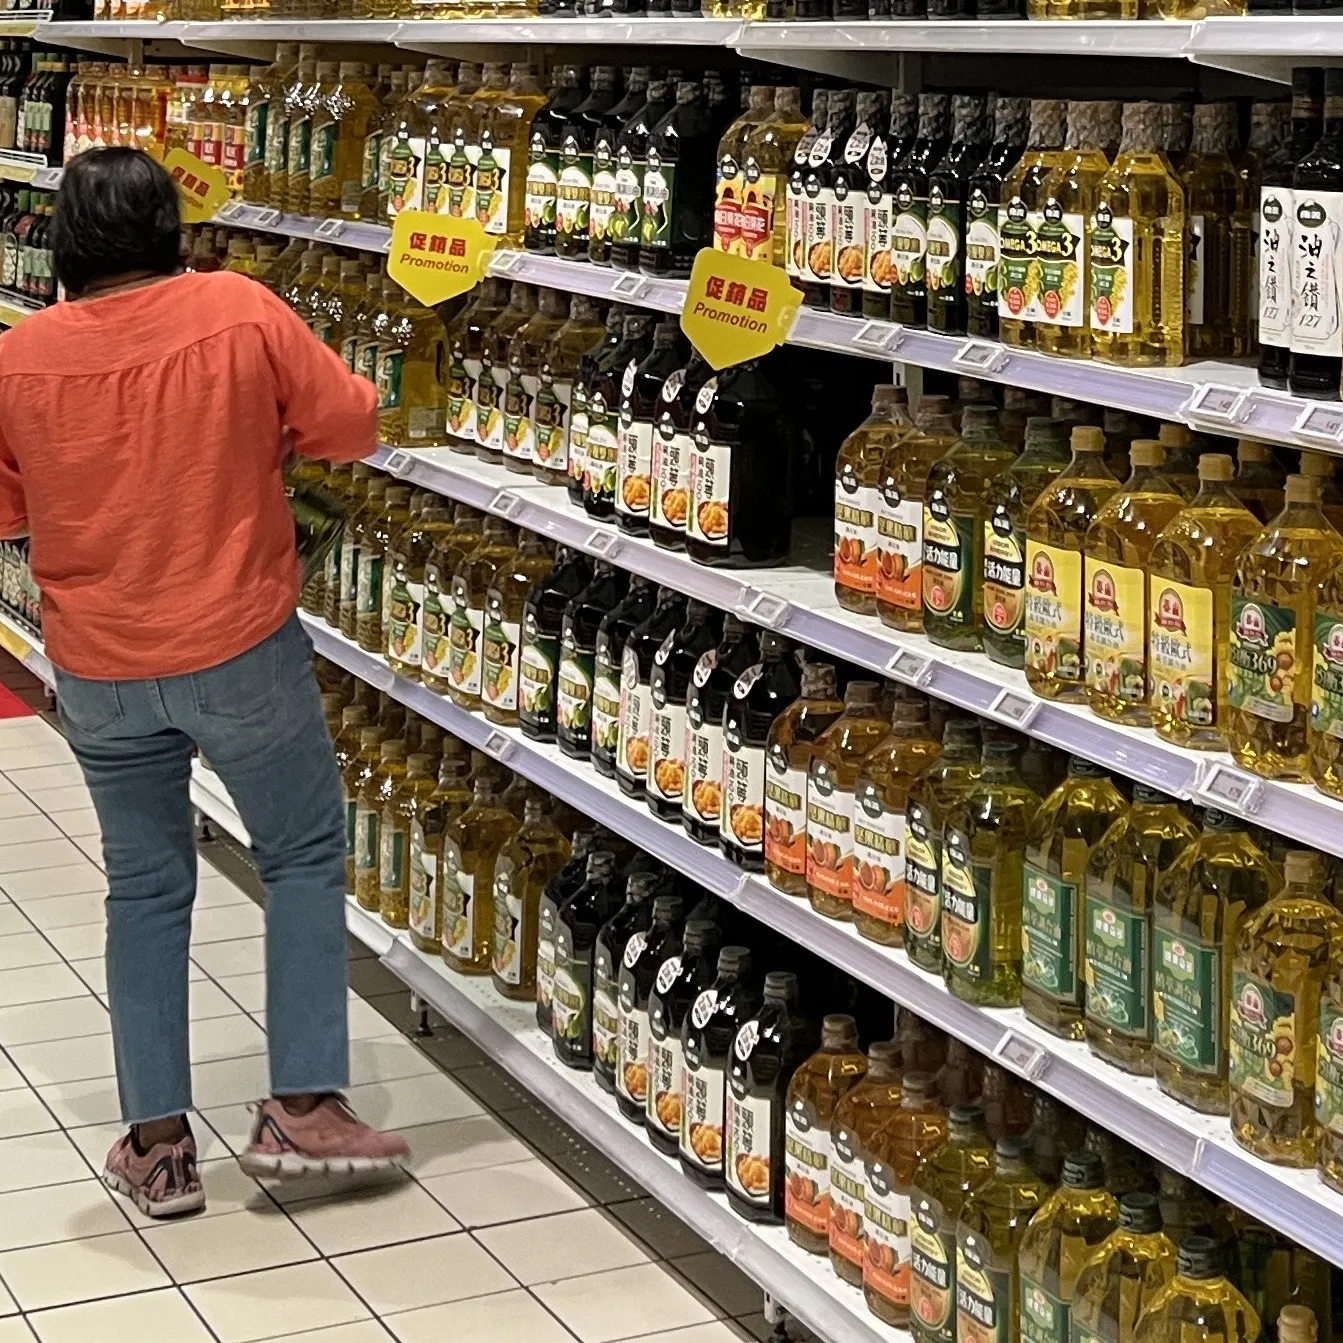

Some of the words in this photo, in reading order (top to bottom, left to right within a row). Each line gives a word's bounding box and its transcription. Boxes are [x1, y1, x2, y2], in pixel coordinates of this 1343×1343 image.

[410, 233, 466, 257] 促銷品
[400, 253, 469, 275] Promotion
[705, 276, 768, 311] 促銷品
[693, 302, 768, 335] Promotion
